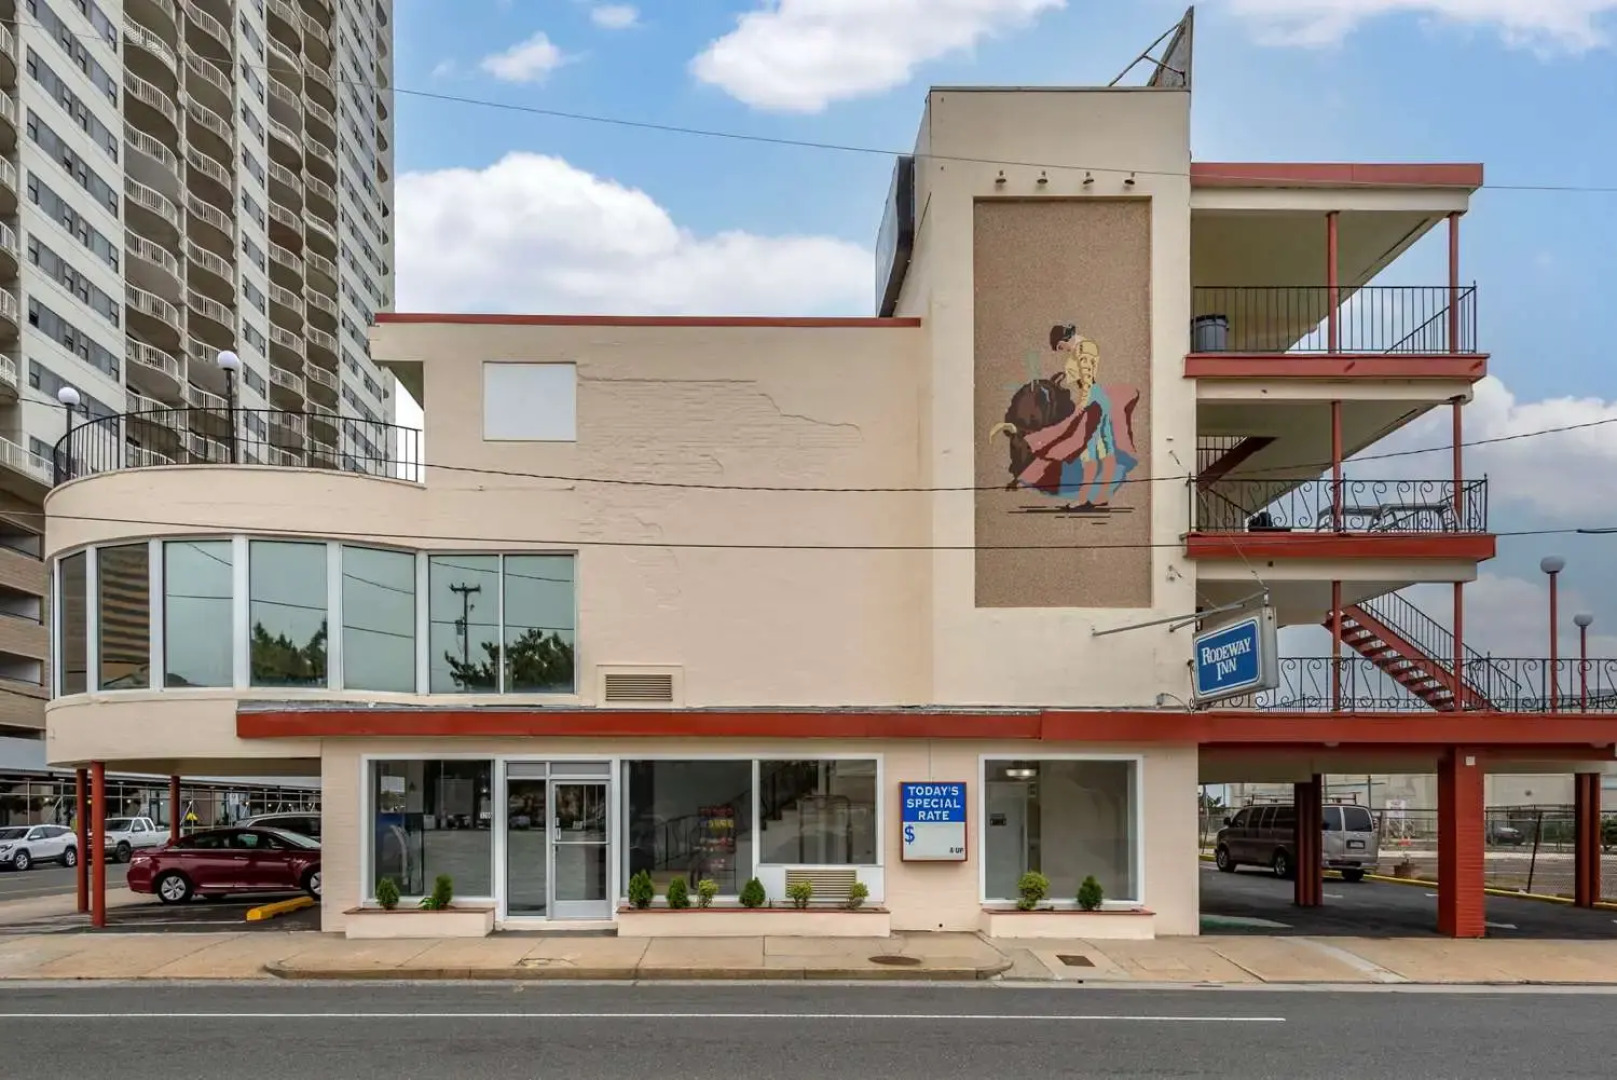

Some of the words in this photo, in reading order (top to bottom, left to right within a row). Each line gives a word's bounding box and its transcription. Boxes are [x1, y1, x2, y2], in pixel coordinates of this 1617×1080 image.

[1201, 637, 1251, 666] RODEWAY
[1216, 657, 1237, 681] INN
[907, 786, 959, 796] TODAY'S
[906, 798, 961, 808] SPECIAL
[918, 811, 950, 821] RATE
[904, 825, 915, 845] $
